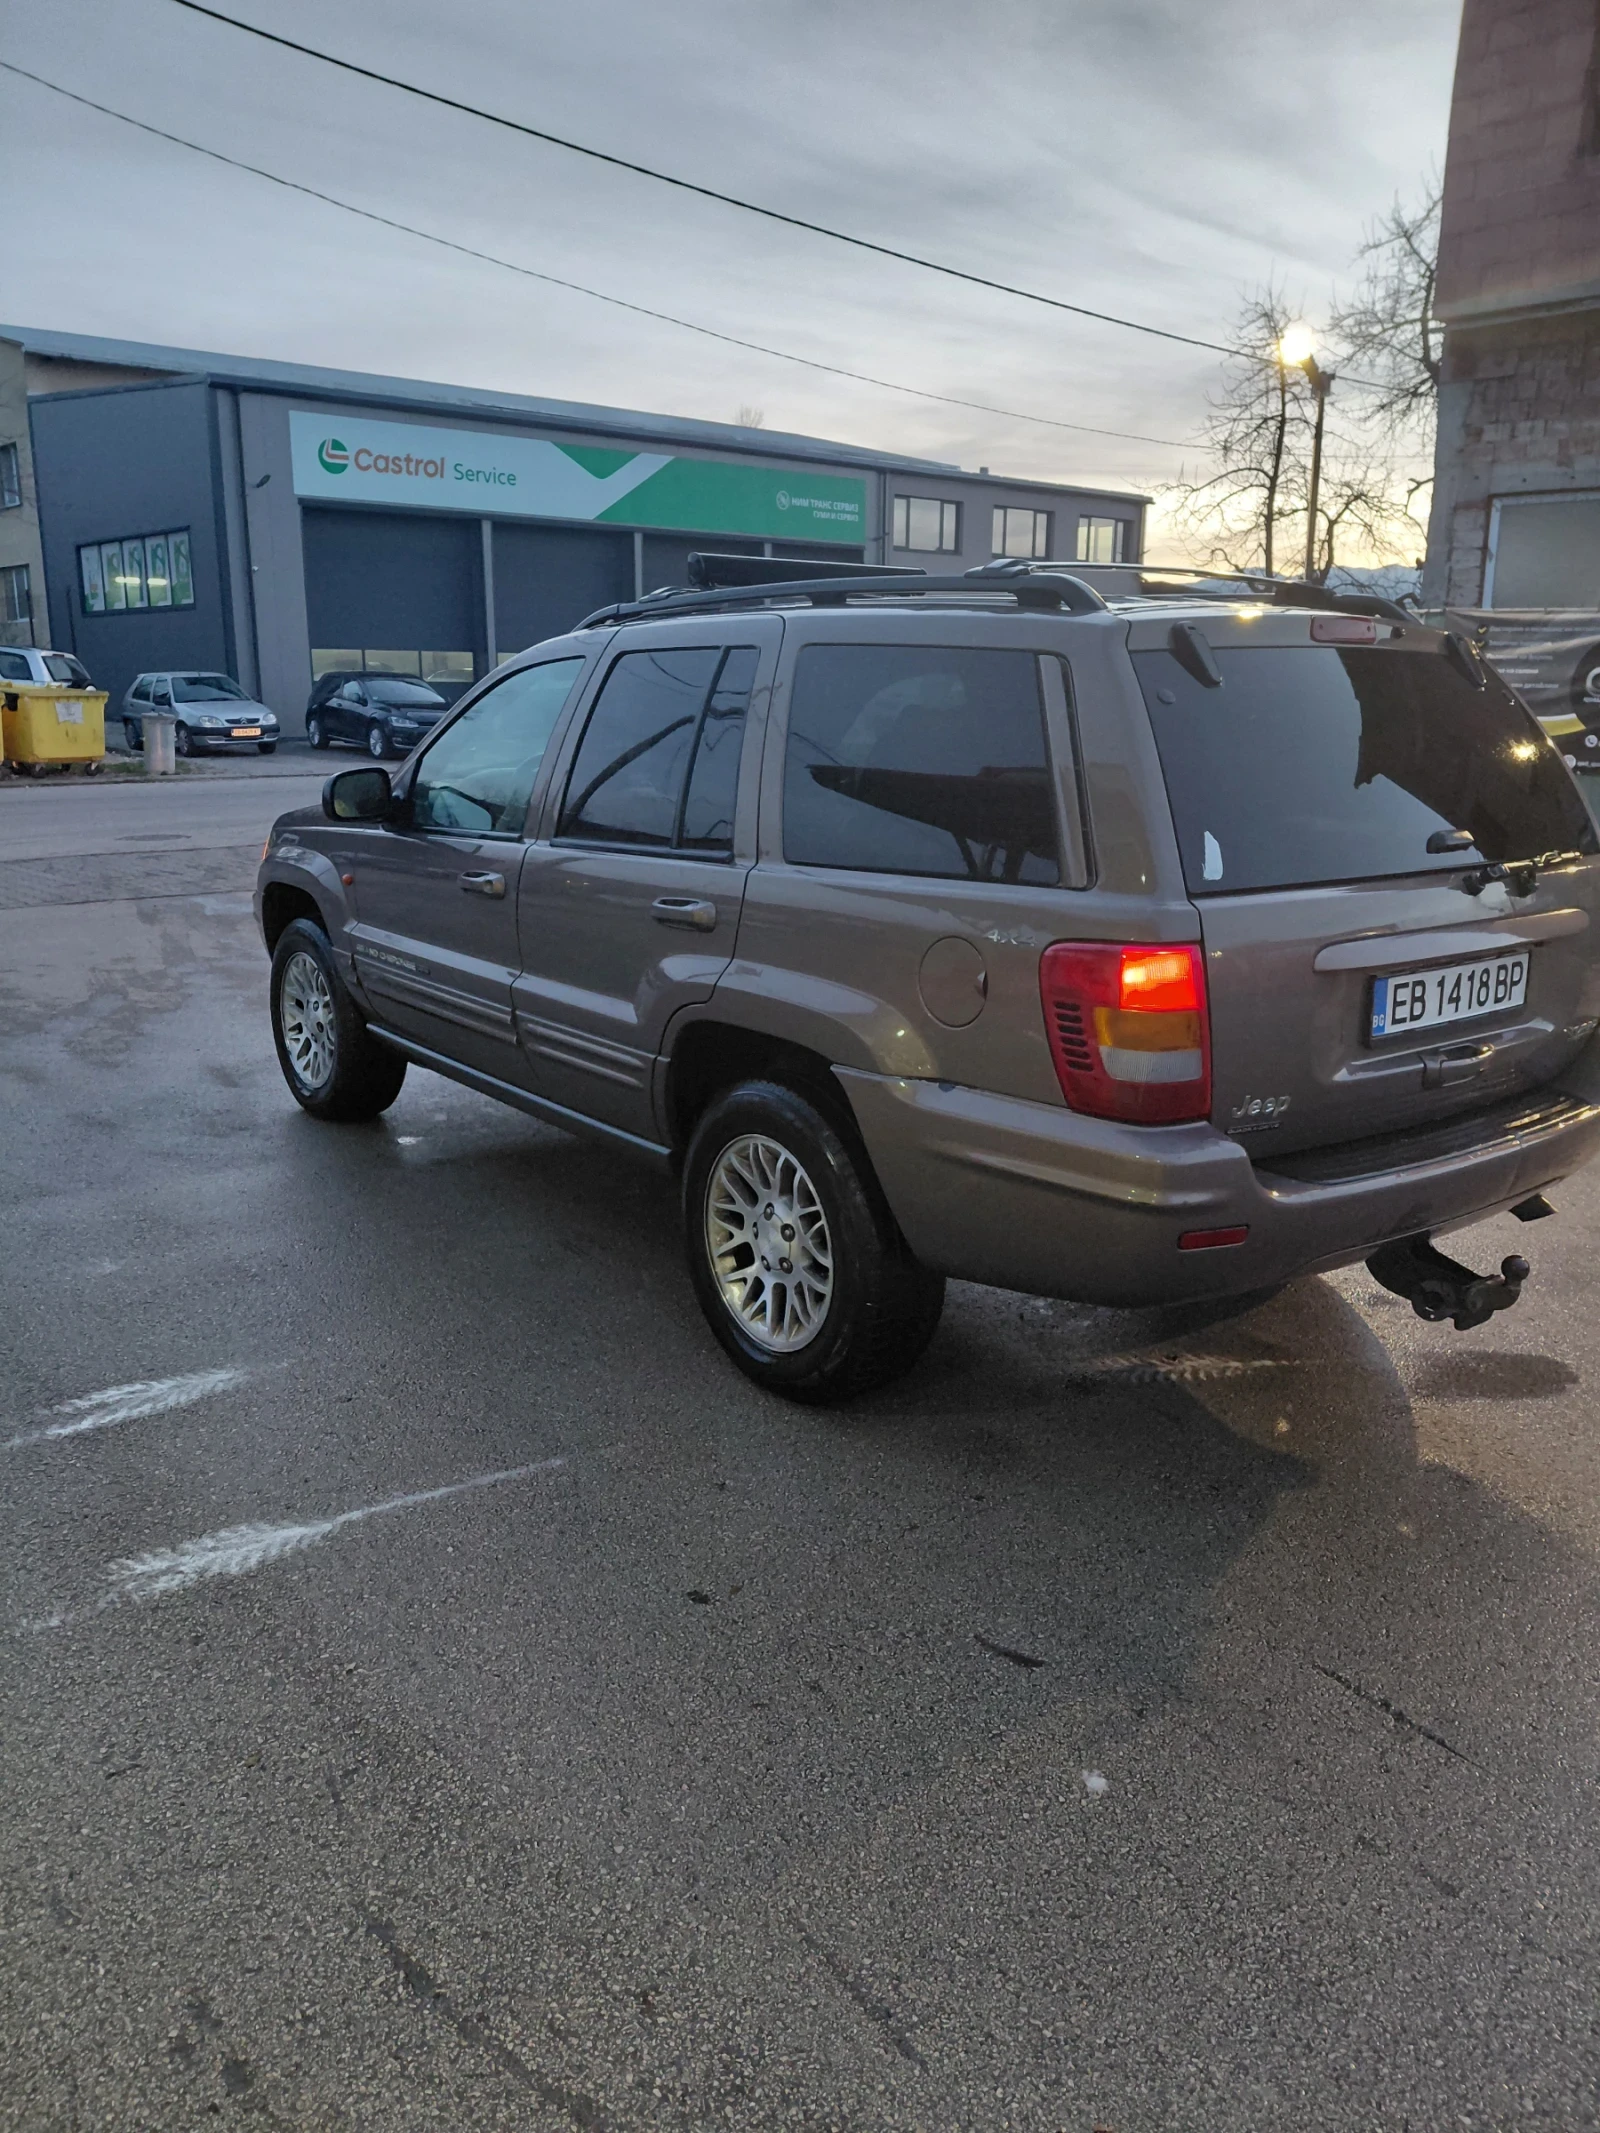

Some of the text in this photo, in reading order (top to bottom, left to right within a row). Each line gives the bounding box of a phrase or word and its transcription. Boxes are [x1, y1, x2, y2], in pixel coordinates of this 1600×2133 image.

[354, 448, 517, 486] Castrol Service
[810, 499, 832, 510] ТРАНС
[833, 502, 859, 512] СЕРВИЗ
[1391, 961, 1524, 1026] EB 1418 BP
[1372, 1014, 1386, 1029] BG
[1232, 1096, 1292, 1119] Jeep
